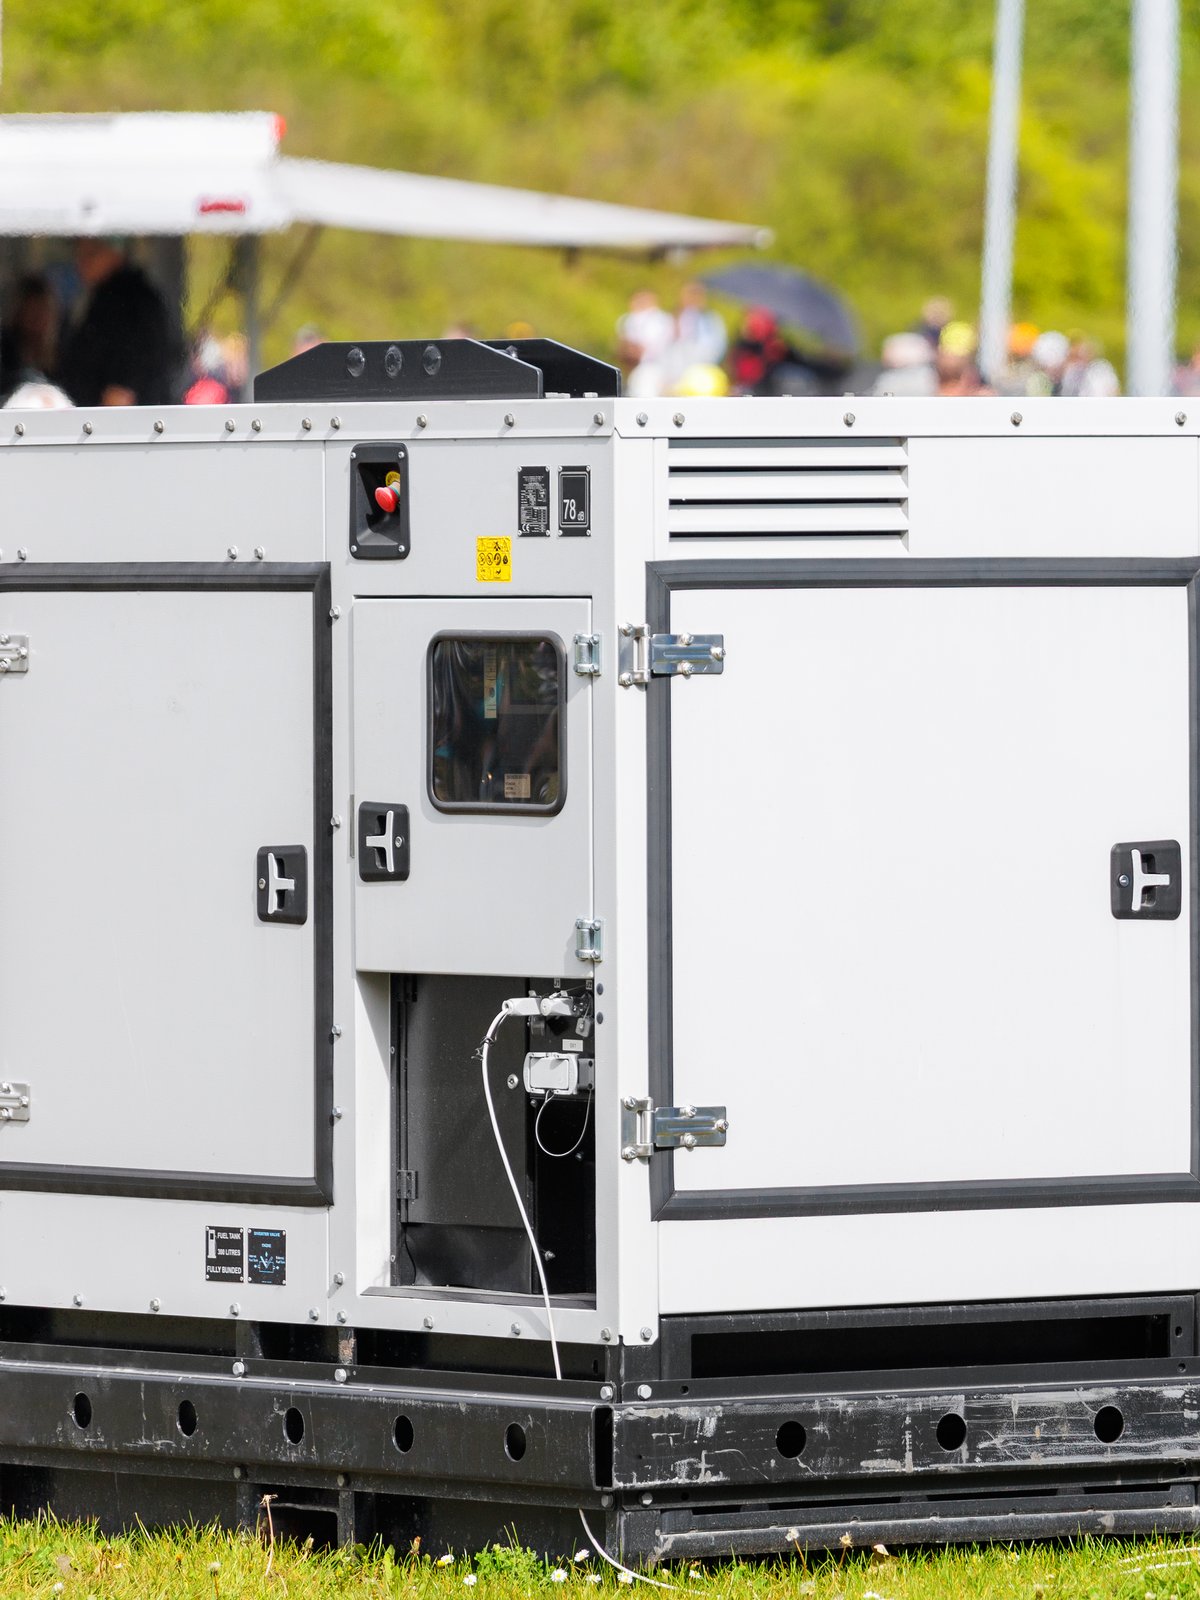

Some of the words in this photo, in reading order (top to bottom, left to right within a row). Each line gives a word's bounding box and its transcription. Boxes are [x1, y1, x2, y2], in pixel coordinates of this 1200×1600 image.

[563, 499, 576, 520] 78
[577, 511, 584, 520] dB
[222, 1266, 241, 1274] BUNDED
